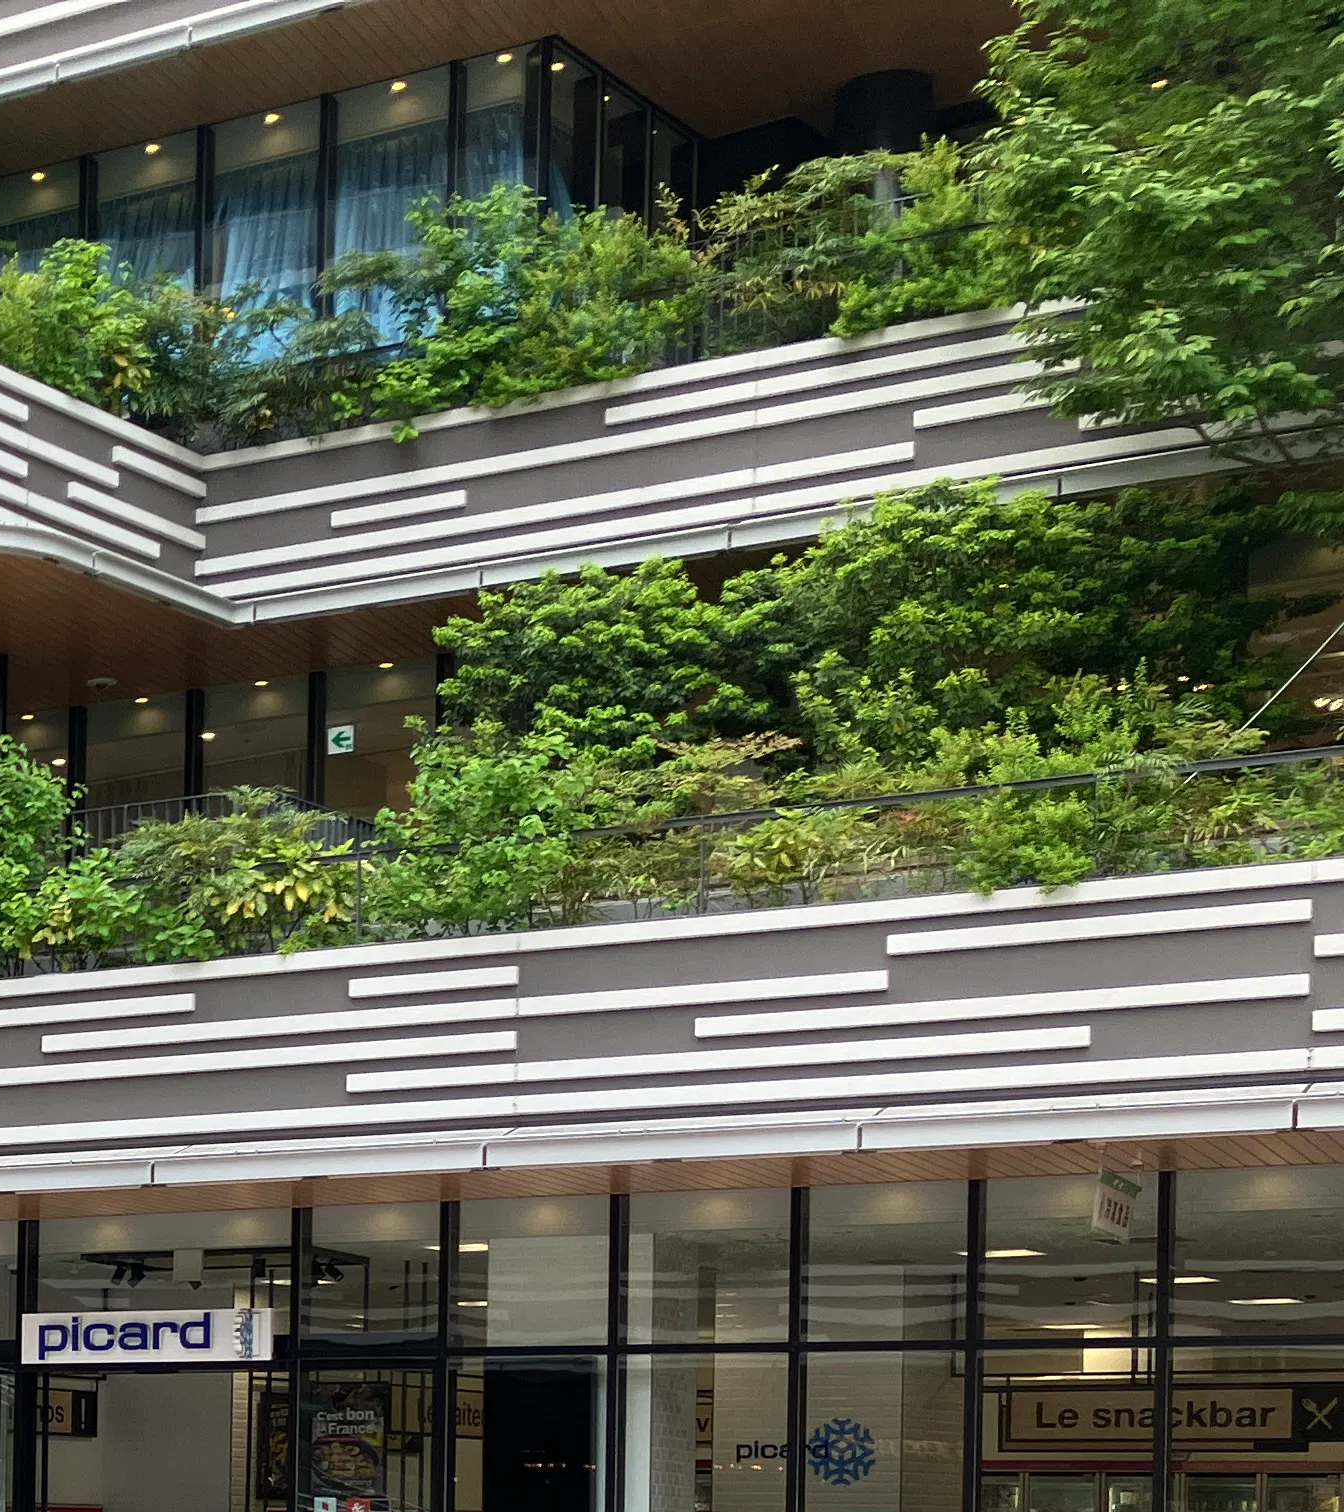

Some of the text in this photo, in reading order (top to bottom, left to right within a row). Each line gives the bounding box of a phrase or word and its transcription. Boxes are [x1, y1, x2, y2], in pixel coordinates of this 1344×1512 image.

[38, 1311, 211, 1361] picard
[346, 1408, 374, 1421] bon
[1035, 1401, 1078, 1428] Le
